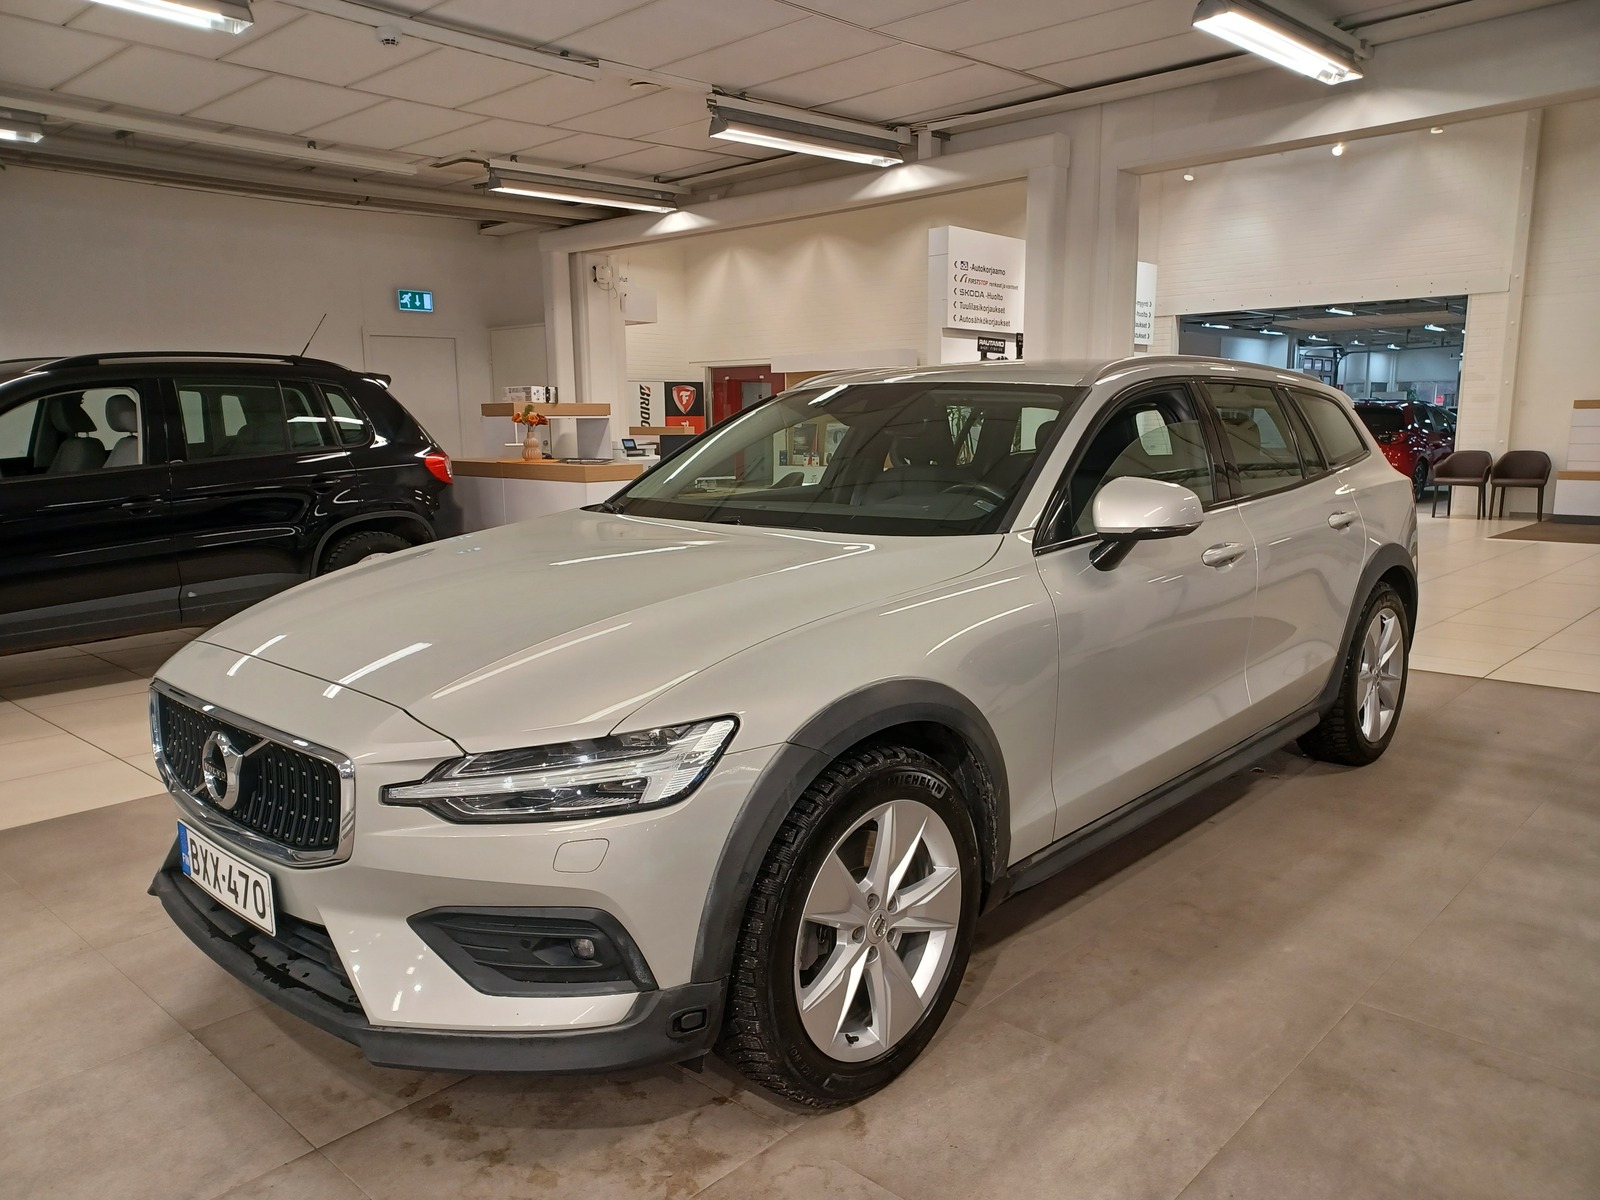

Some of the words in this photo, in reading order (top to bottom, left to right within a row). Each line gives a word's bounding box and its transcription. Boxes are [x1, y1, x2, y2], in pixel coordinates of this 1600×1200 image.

[967, 277, 989, 286] FIRSTSTOP
[959, 301, 1006, 314] Tuulilasikorjaukset
[203, 762, 226, 780] VOLVO
[887, 772, 944, 795] MICHELIN
[188, 837, 266, 920] BXX-470
